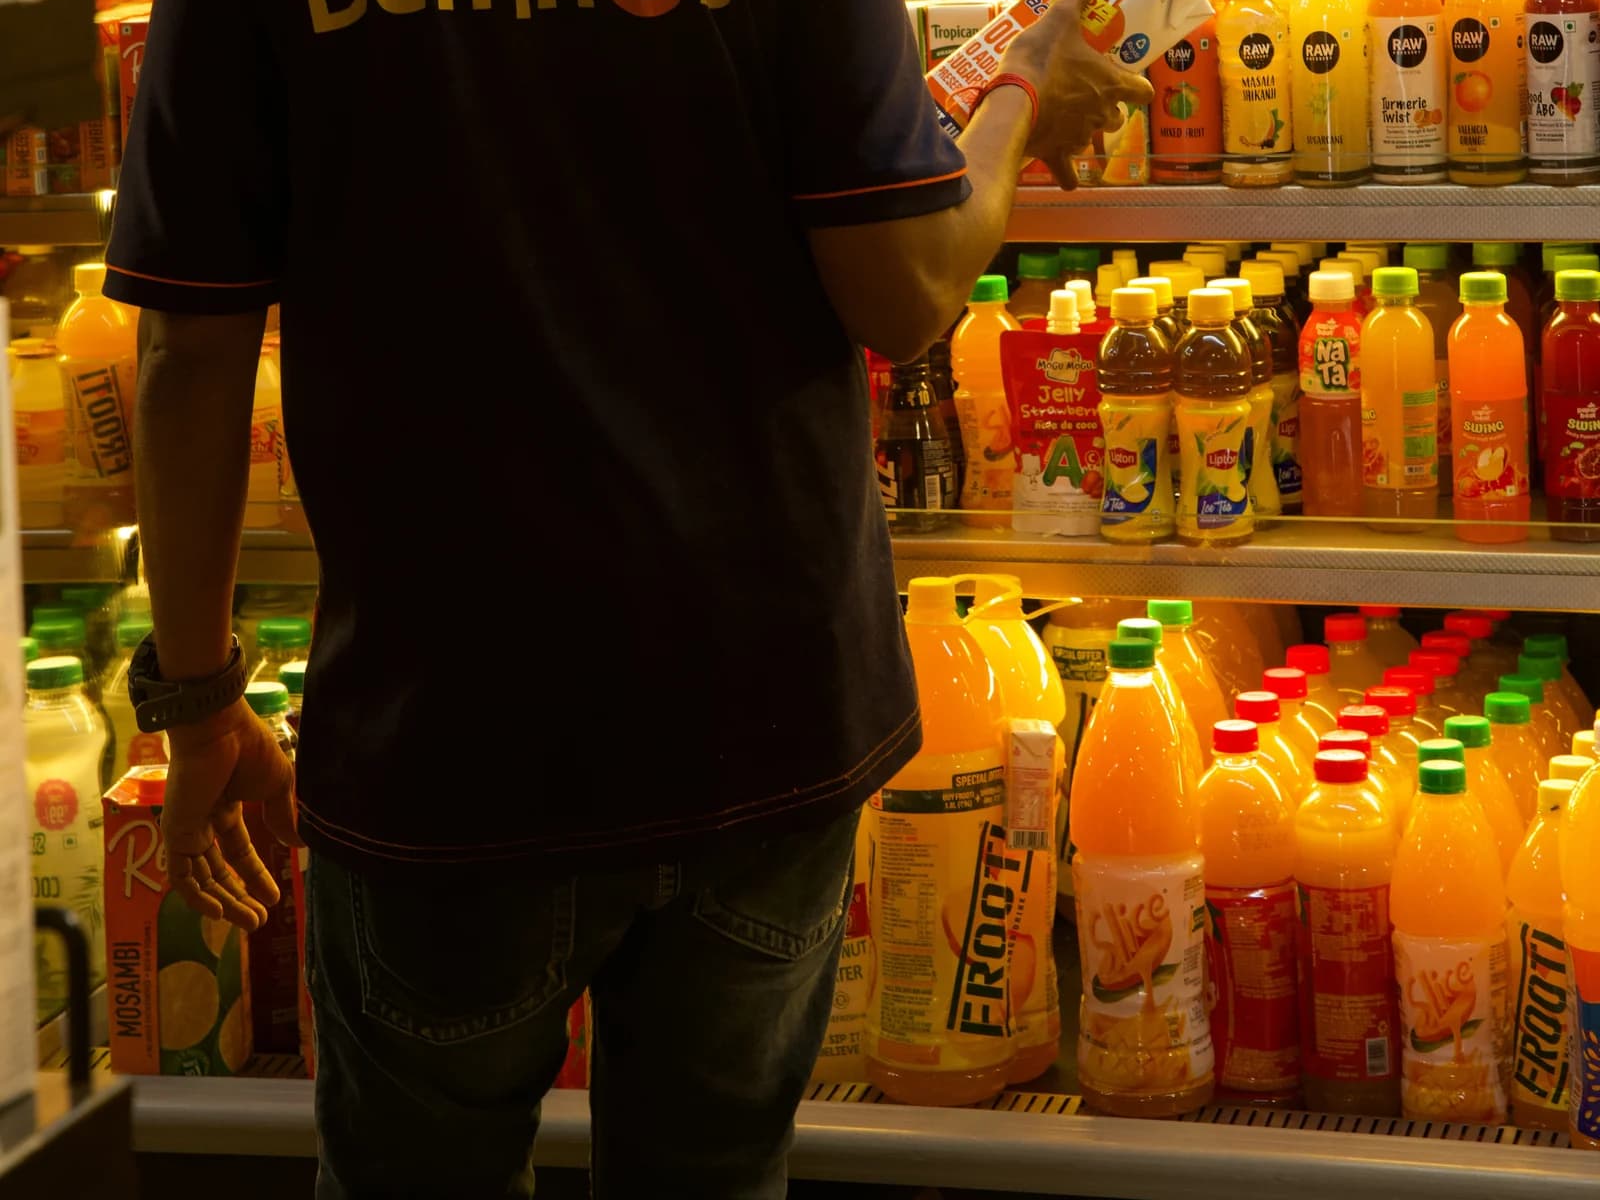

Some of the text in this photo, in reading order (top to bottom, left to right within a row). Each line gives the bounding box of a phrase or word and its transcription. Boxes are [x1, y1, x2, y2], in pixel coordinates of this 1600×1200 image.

[931, 24, 979, 41] Tropican
[1454, 32, 1483, 44] RAW
[1392, 38, 1423, 50] RAW
[1531, 34, 1558, 46] RAW
[1242, 44, 1270, 55] RAW
[1305, 44, 1335, 57] RAW
[1382, 97, 1427, 110] Turmeric
[1536, 103, 1555, 117] ABC
[1382, 110, 1410, 123] Twist
[1038, 385, 1086, 403] Jelly
[1020, 403, 1097, 419] Strawberr
[1567, 418, 1600, 431] SWIN
[1111, 451, 1136, 465] Lipton
[112, 941, 144, 1039] MOSAMBI
[1515, 925, 1567, 1099] FROOTI
